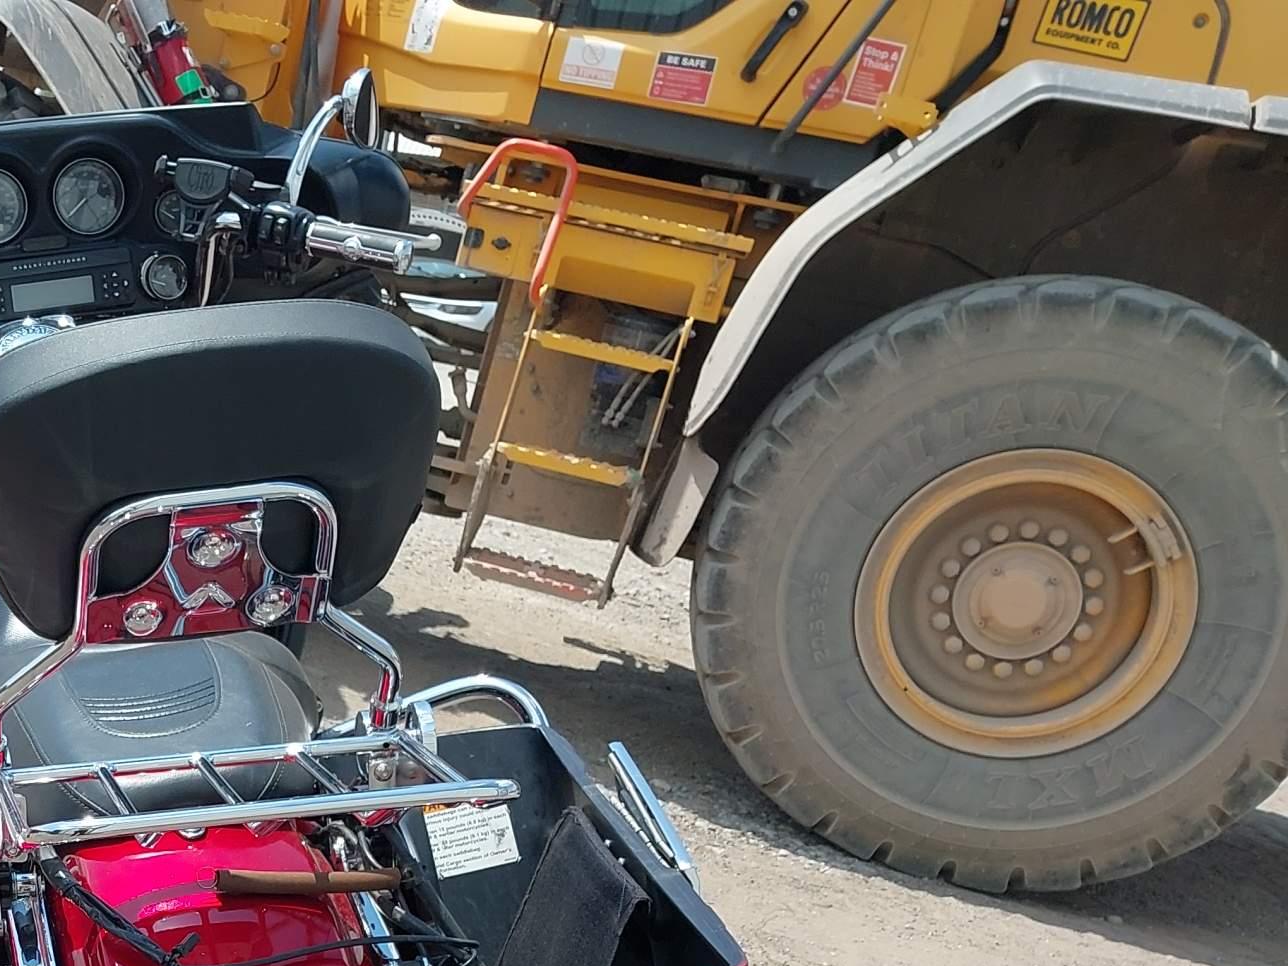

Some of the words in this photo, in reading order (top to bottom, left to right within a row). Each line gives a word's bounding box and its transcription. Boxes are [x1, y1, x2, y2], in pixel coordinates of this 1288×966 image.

[1050, 0, 1135, 38] ROMCO
[1045, 28, 1103, 46] EQUIPMENT
[863, 45, 889, 60] Stop
[666, 54, 680, 65] BE
[681, 56, 708, 69] SAFE
